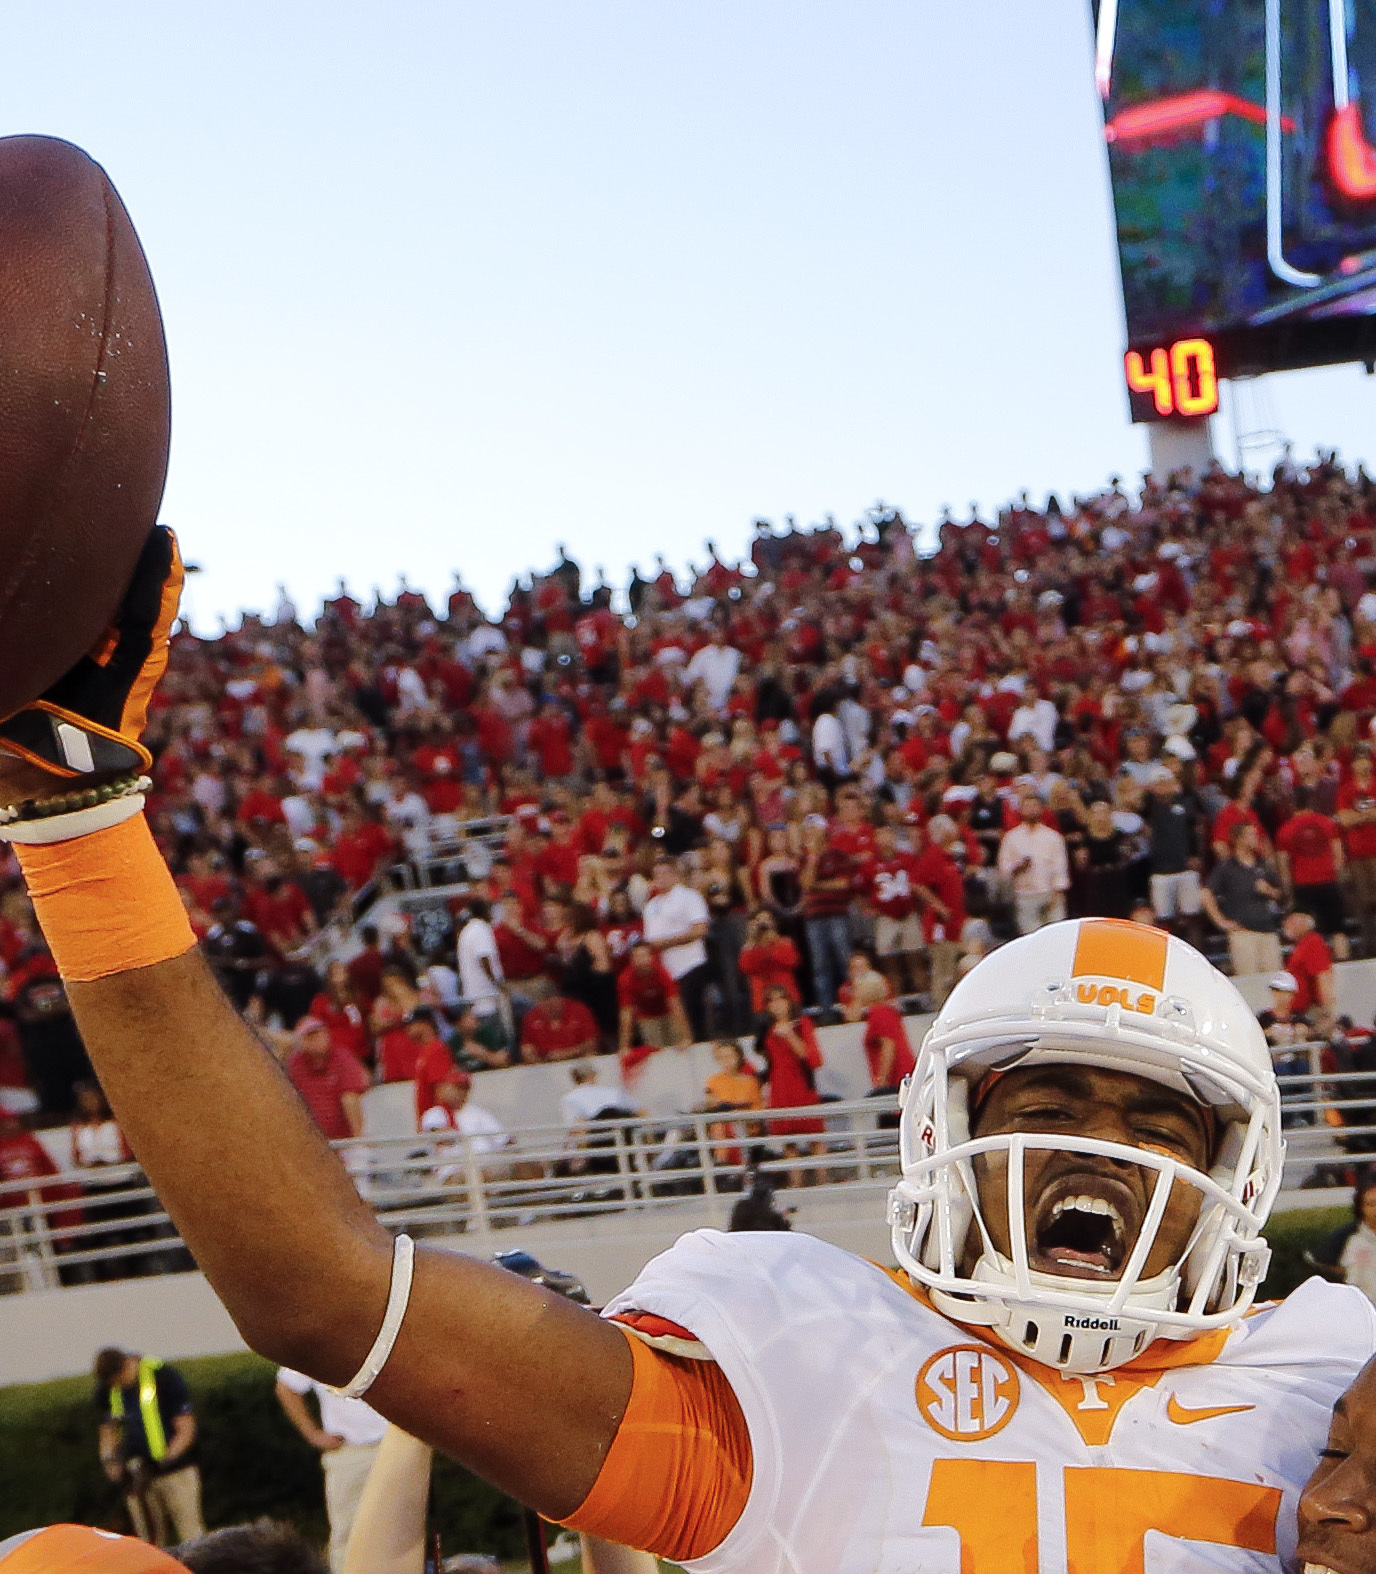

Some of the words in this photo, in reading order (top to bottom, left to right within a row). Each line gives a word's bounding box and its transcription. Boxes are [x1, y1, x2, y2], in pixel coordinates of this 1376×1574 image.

[1126, 338, 1218, 416] 40
[1078, 984, 1155, 1014] VOLS
[1064, 1315, 1121, 1331] Riddell
[927, 1351, 1011, 1433] SEC
[1062, 1372, 1116, 1409] T
